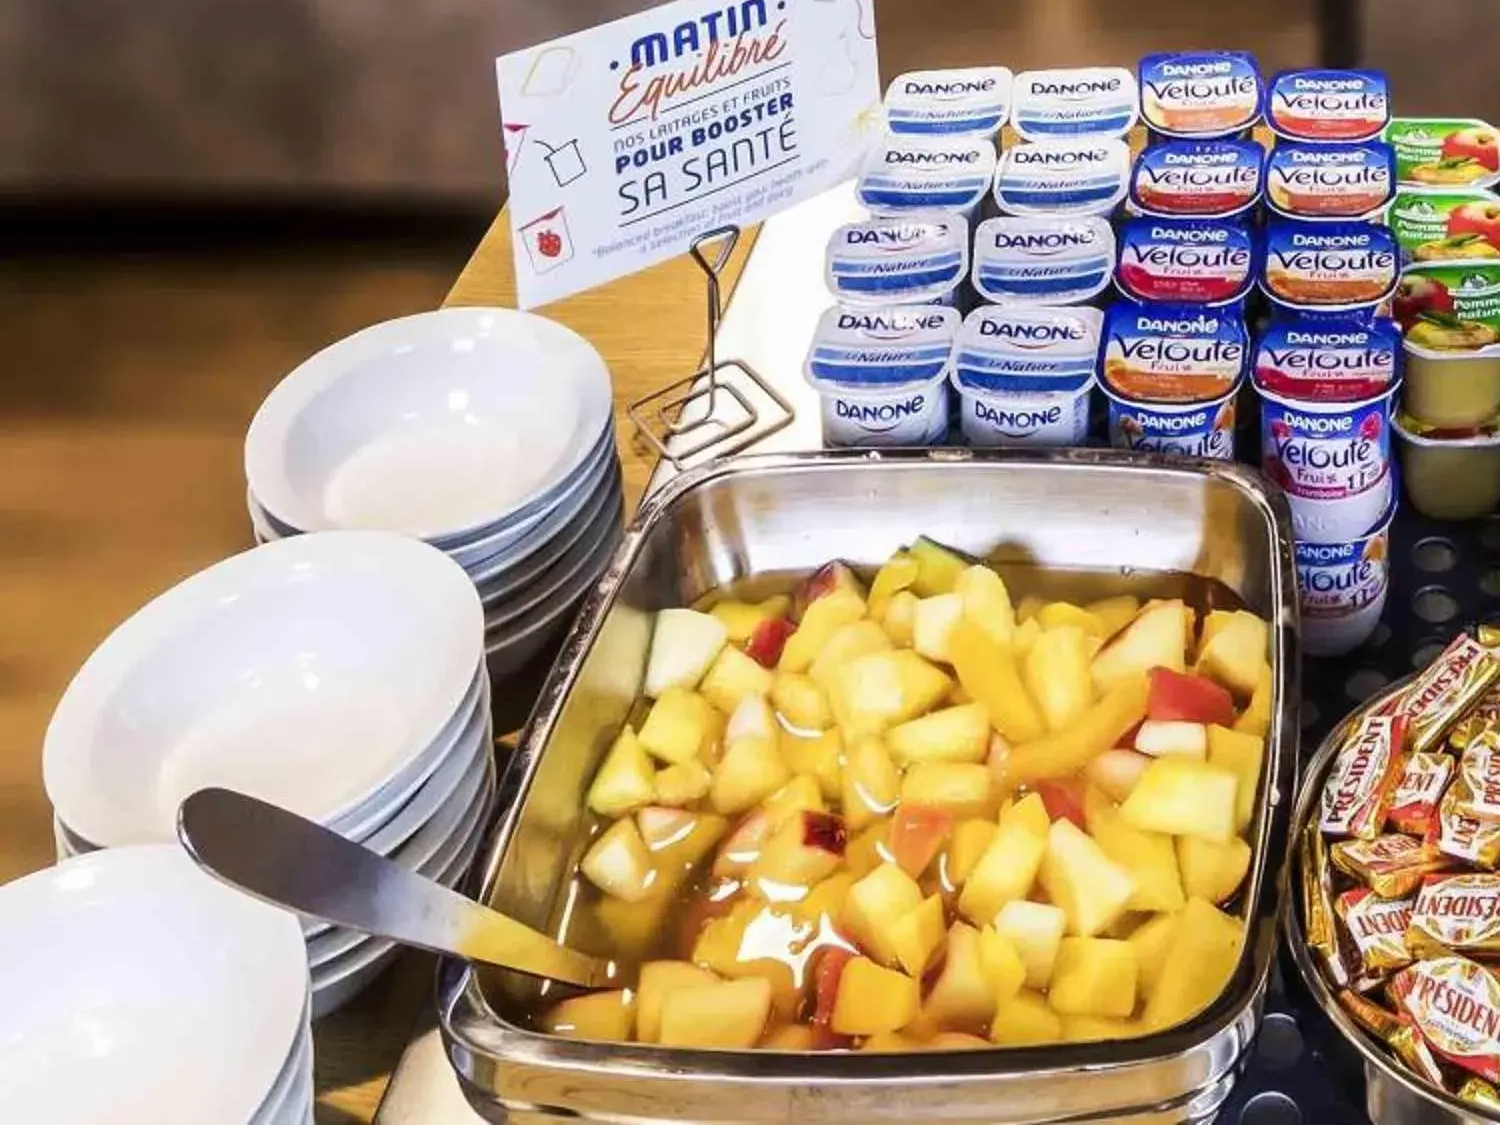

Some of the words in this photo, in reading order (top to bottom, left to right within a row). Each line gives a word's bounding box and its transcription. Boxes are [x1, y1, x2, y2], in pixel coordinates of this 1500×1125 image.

[1163, 62, 1233, 76] DANONE
[904, 78, 997, 95] DANONE
[1030, 78, 1122, 95] DANONE
[1146, 76, 1254, 100] Velouté
[1295, 78, 1364, 90] DANONE
[649, 105, 720, 141] LAITAGES
[722, 97, 739, 114] ET
[743, 76, 792, 106] FRUITS
[1276, 89, 1386, 111] Velouté
[615, 136, 684, 174] POUR
[691, 91, 794, 148] BOOSTER
[618, 170, 668, 216] SA
[681, 111, 798, 193] SANTÉ
[885, 149, 980, 165] DANONE
[1165, 151, 1239, 164] DANONE
[1293, 150, 1366, 164] DANONE
[1143, 164, 1258, 186] Velouté
[1274, 164, 1388, 186] Velouté
[1152, 227, 1229, 242] DANONE
[1293, 234, 1371, 247] DANONE
[1132, 242, 1249, 267] Velouté
[1267, 247, 1394, 271] Velouté
[1137, 317, 1220, 334] DANONE
[1114, 332, 1241, 362] Velouté
[1287, 332, 1369, 345] DANONE
[1263, 346, 1392, 371] Velouté
[836, 394, 927, 421] DANONE
[975, 401, 1062, 426] DANONE
[1137, 412, 1207, 431] DANONE
[1283, 412, 1353, 431] DANONE
[1276, 436, 1371, 469] Velouté
[1298, 560, 1373, 592] elouté
[1326, 719, 1385, 824] PRÉSIDENT
